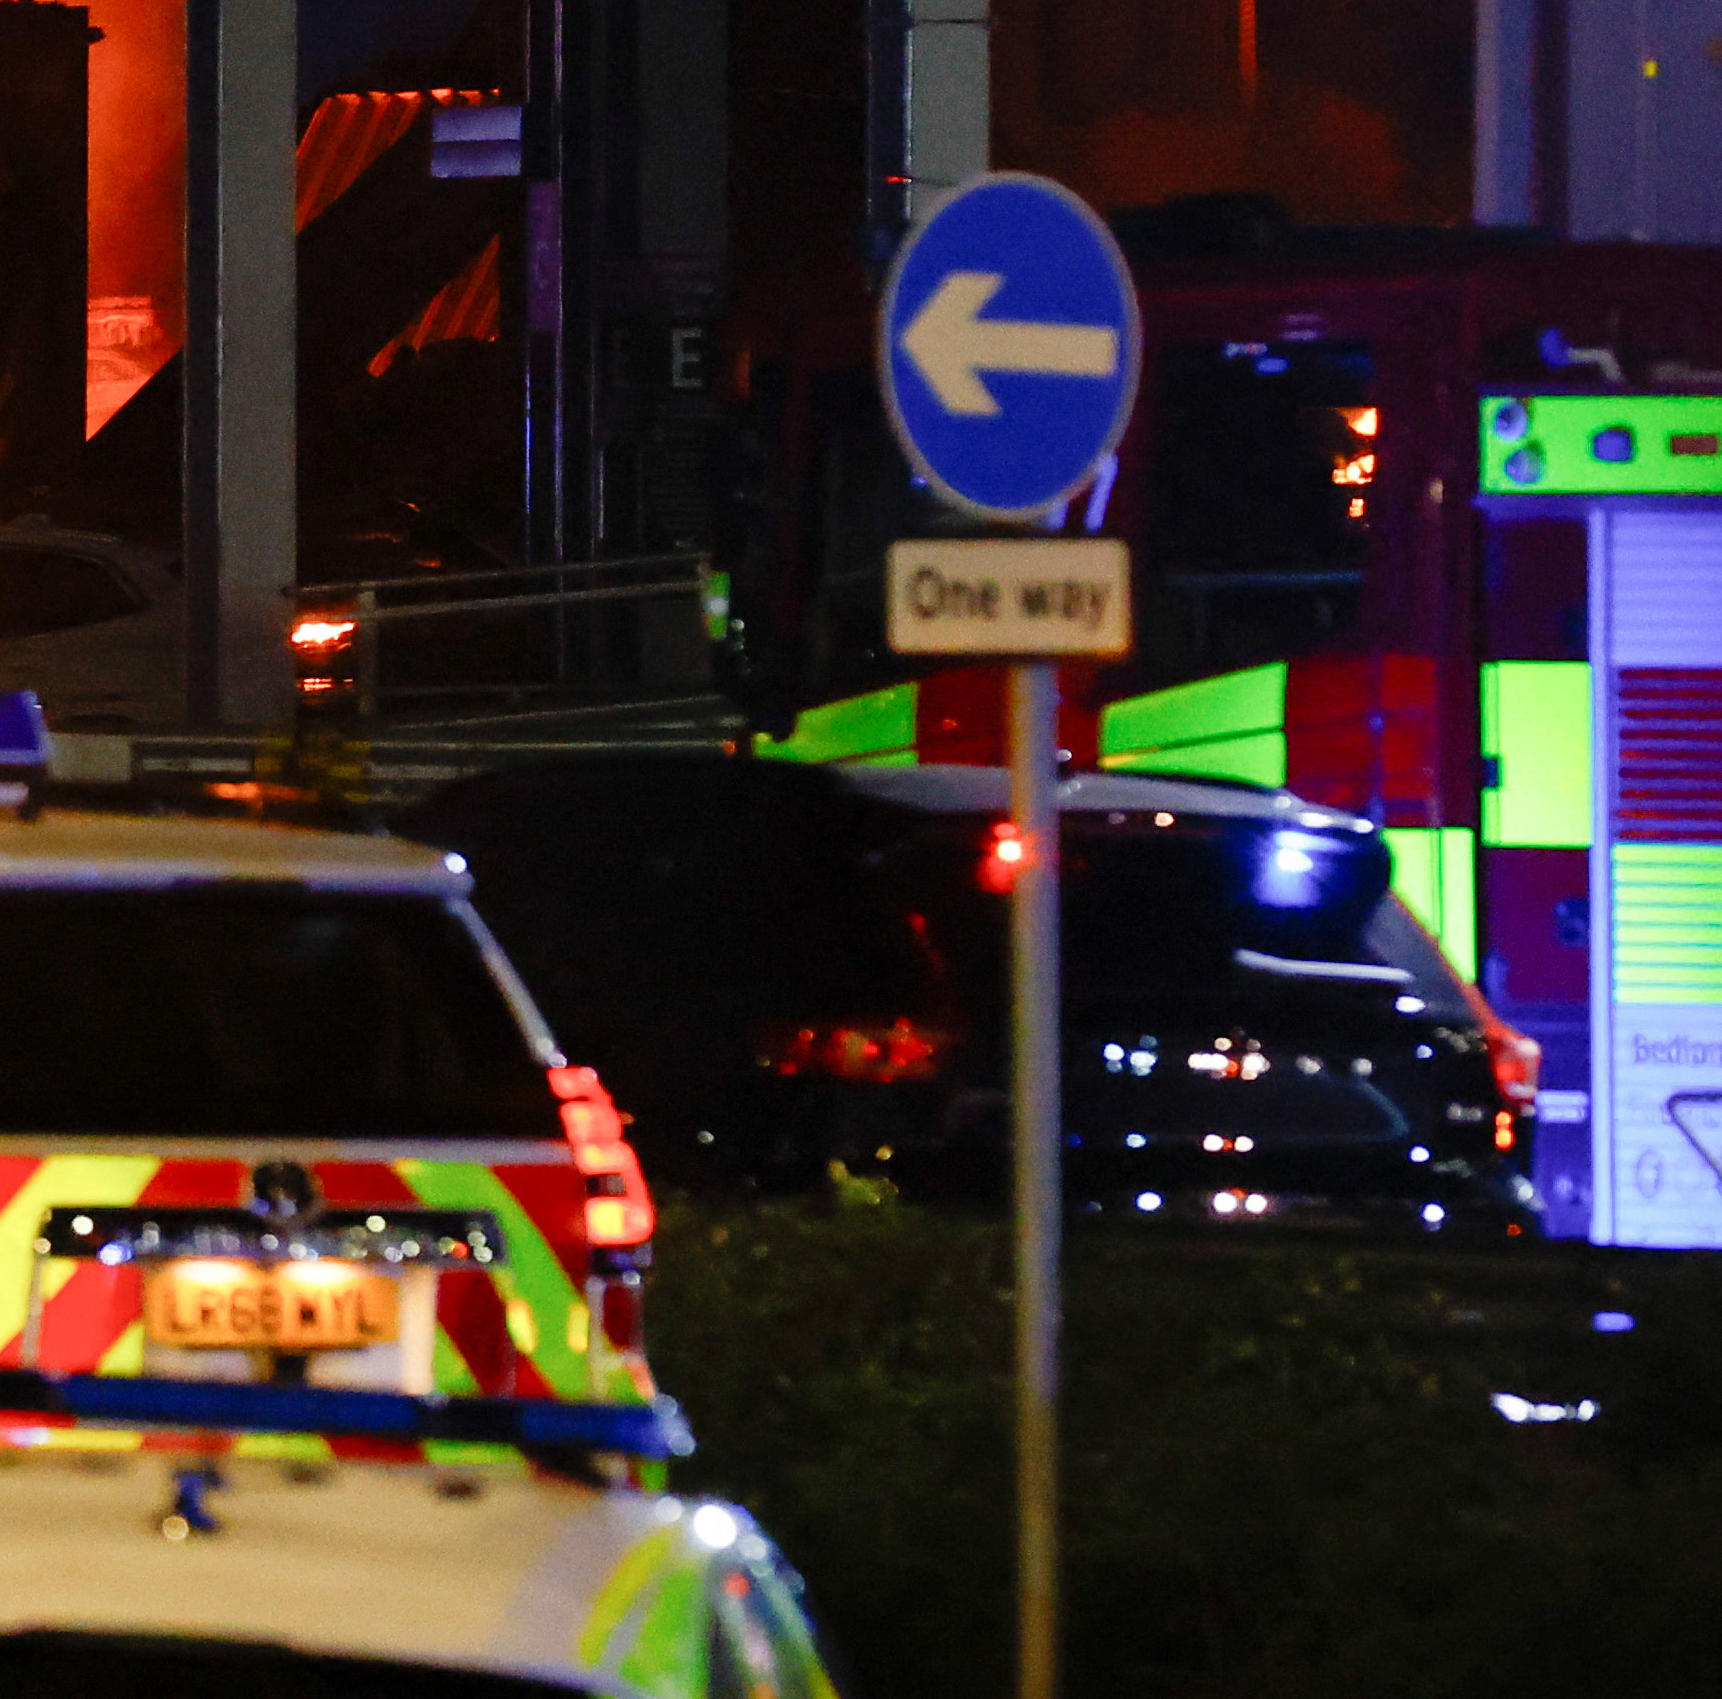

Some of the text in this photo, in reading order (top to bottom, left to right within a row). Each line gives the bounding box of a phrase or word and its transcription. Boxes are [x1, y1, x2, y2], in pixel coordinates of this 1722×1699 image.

[670, 327, 705, 389] E
[906, 567, 1111, 630] One way
